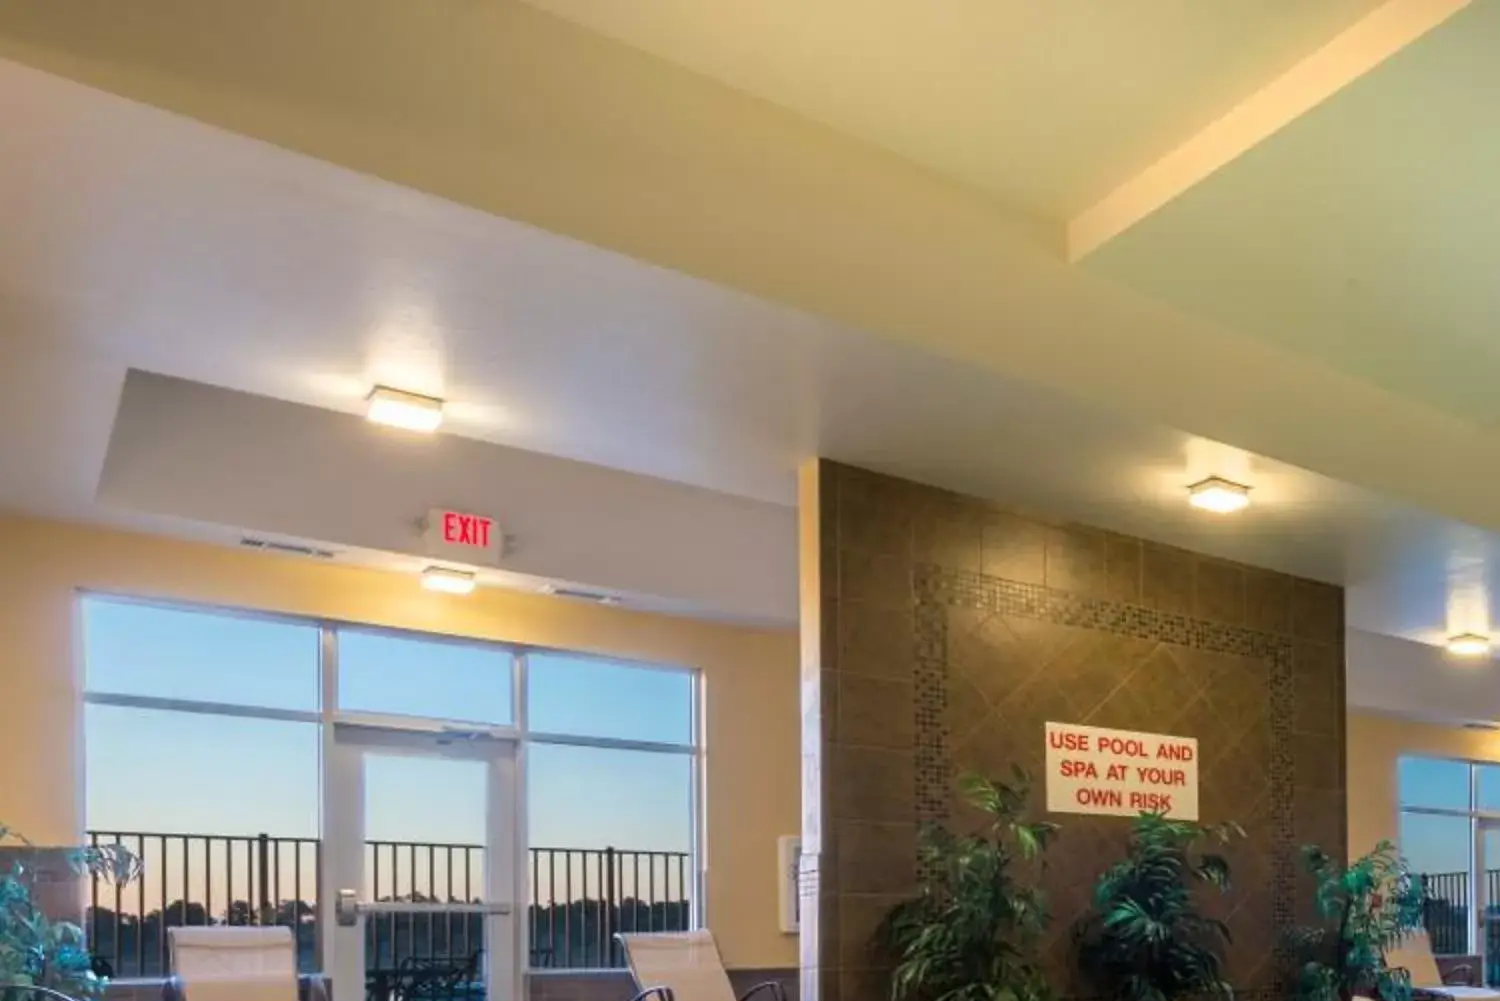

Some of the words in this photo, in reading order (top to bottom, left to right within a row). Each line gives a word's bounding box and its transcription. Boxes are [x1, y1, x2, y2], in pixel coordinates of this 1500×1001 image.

[443, 512, 492, 547] EXIT
[1049, 731, 1089, 751] USE
[1097, 737, 1149, 757] POOL
[1156, 743, 1193, 761] AND
[1060, 760, 1098, 779] SPA
[1106, 764, 1128, 781] AT
[1136, 768, 1186, 786] YOUR
[1076, 788, 1122, 808] OWN
[1130, 791, 1172, 811] RISK
